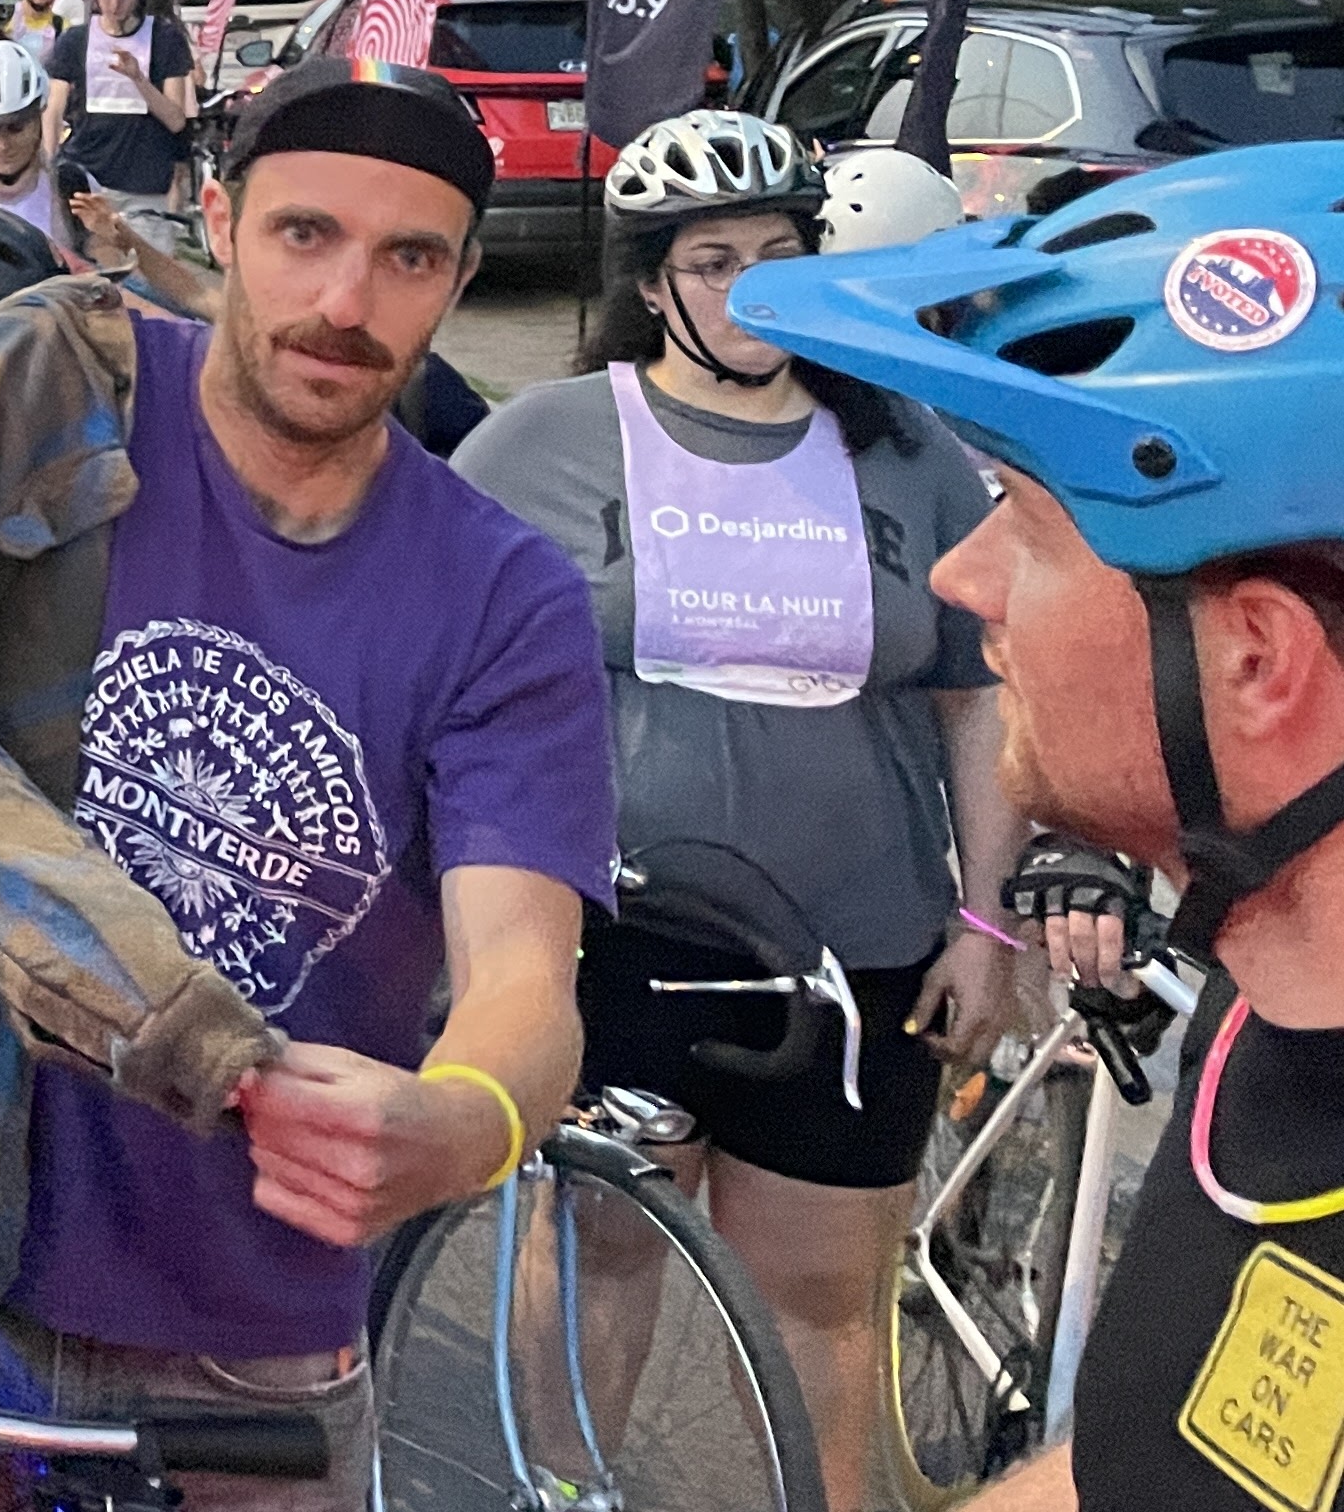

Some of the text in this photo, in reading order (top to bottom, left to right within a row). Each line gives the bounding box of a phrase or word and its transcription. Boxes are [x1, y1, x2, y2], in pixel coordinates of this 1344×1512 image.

[1202, 271, 1265, 322] VOTED
[698, 512, 848, 543] Desjardins
[667, 588, 844, 619] TOUR LA NUIT
[192, 647, 223, 674] DE
[233, 662, 290, 716] LOS
[290, 718, 361, 857] AMIGOS
[1279, 1295, 1330, 1349] THE
[1259, 1331, 1318, 1388] WAR
[1251, 1375, 1291, 1416] ON
[1220, 1398, 1295, 1468] CARS
